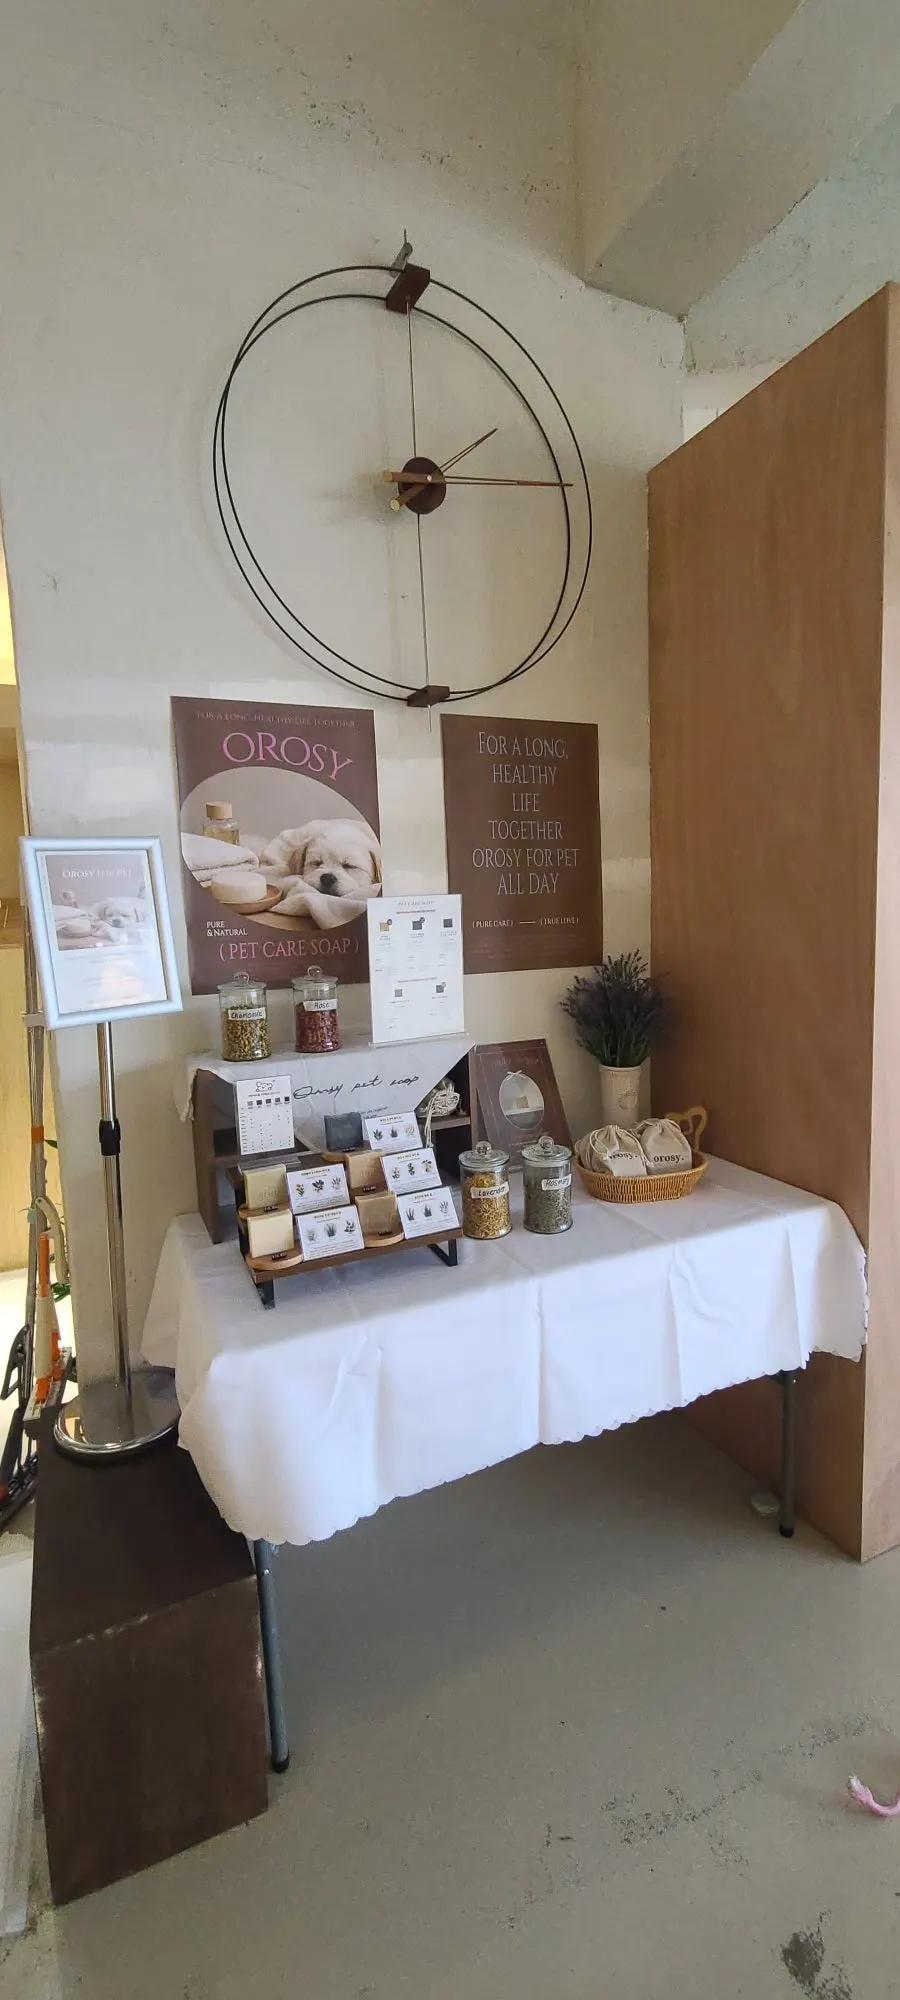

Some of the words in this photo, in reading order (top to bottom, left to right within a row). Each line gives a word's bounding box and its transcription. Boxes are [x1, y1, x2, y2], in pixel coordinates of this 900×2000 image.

[478, 731, 508, 755] FOR
[512, 737, 521, 755] A
[526, 738, 569, 759] LONG,
[223, 731, 353, 780] OROSY
[492, 764, 557, 785] HEALTHY
[512, 793, 540, 812] LIFE
[488, 820, 563, 840] TOGETHER
[472, 848, 520, 868] OROSY
[526, 848, 552, 867] FOR
[557, 848, 580, 867] PET
[62, 869, 95, 878] OROSY
[497, 873, 524, 896] ALL
[529, 873, 559, 894] DAY
[206, 920, 225, 929] PURE
[262, 939, 307, 958] CARE
[350, 1075, 383, 1093] pet
[389, 1075, 420, 1087] soap
[653, 1154, 684, 1164] orosy.
